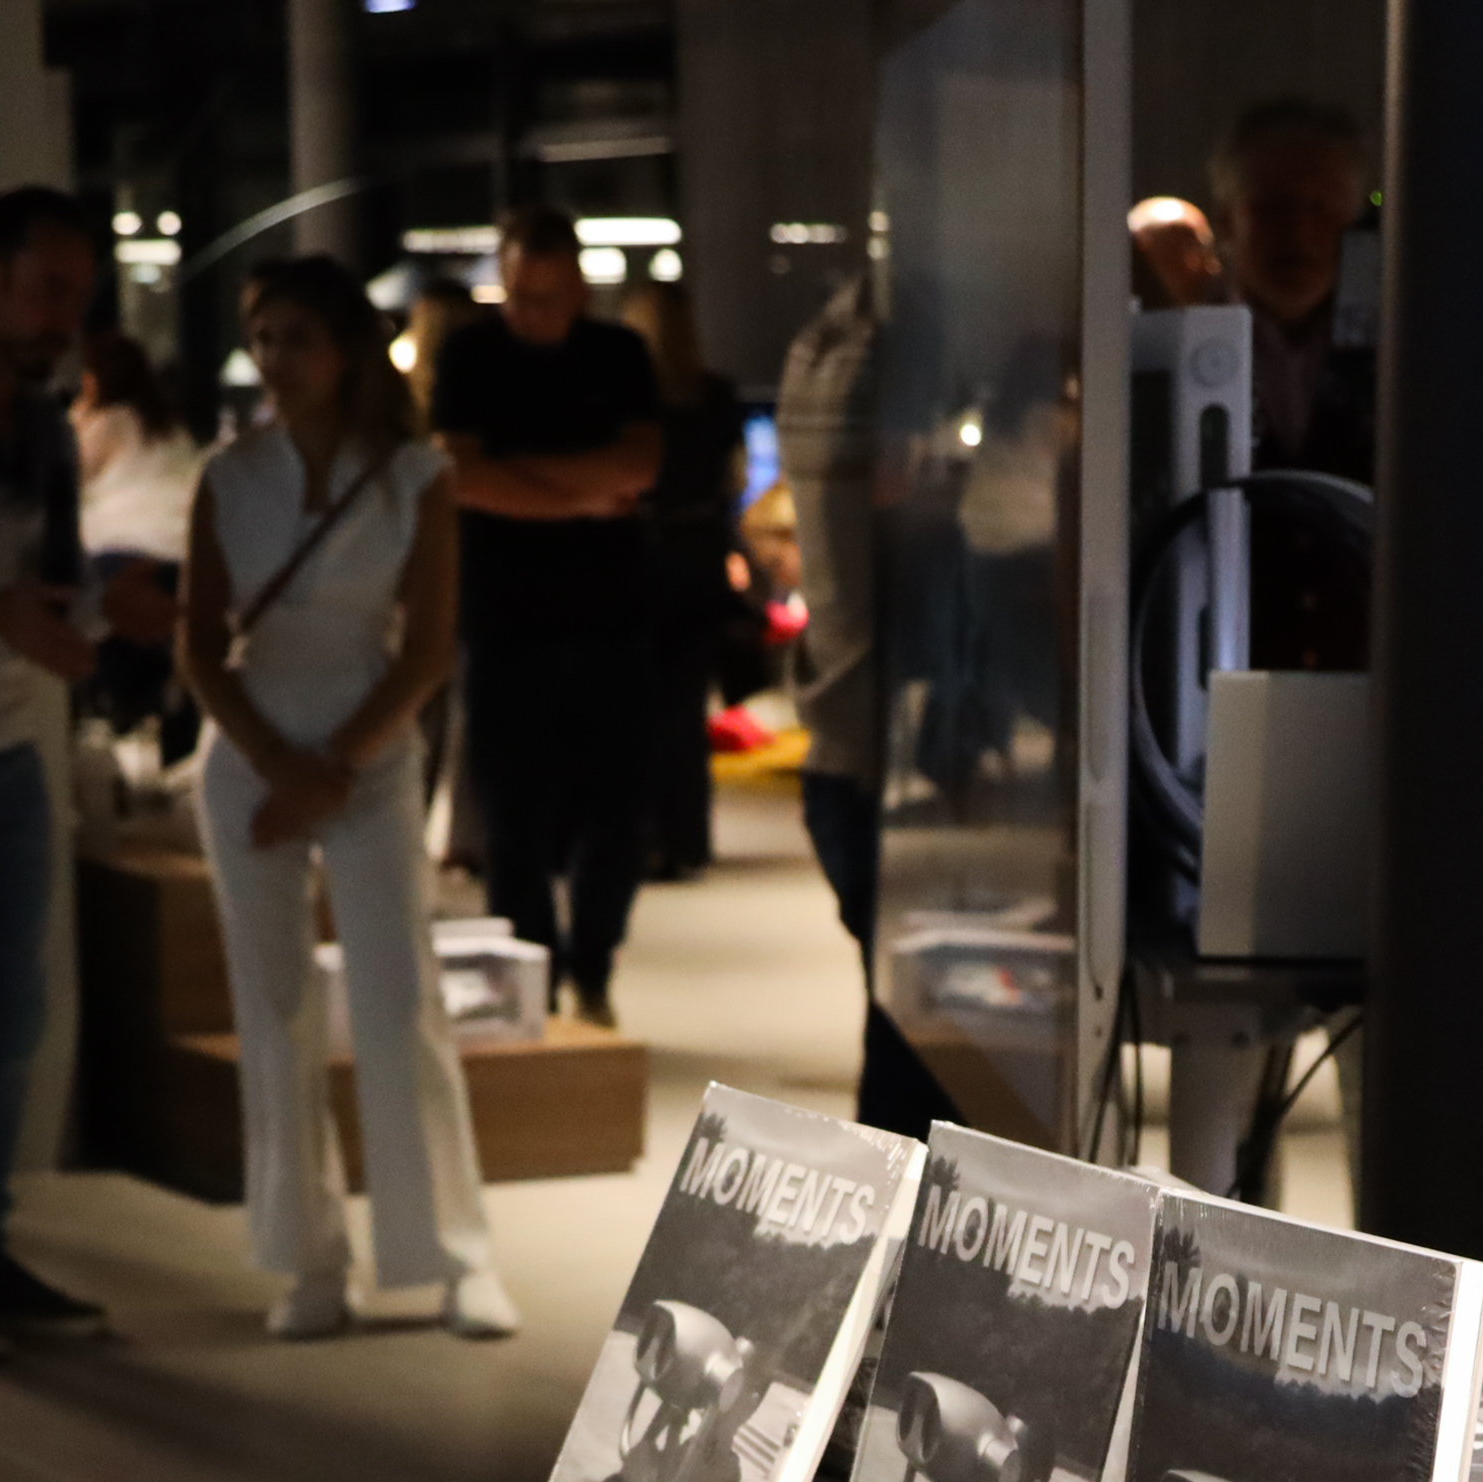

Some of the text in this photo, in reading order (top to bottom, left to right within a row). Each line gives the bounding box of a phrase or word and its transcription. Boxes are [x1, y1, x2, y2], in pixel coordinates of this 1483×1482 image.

[678, 1136, 876, 1246] MOMENTS
[919, 1184, 1136, 1309] MOMENTS
[1157, 1260, 1428, 1399] MOMENTS
